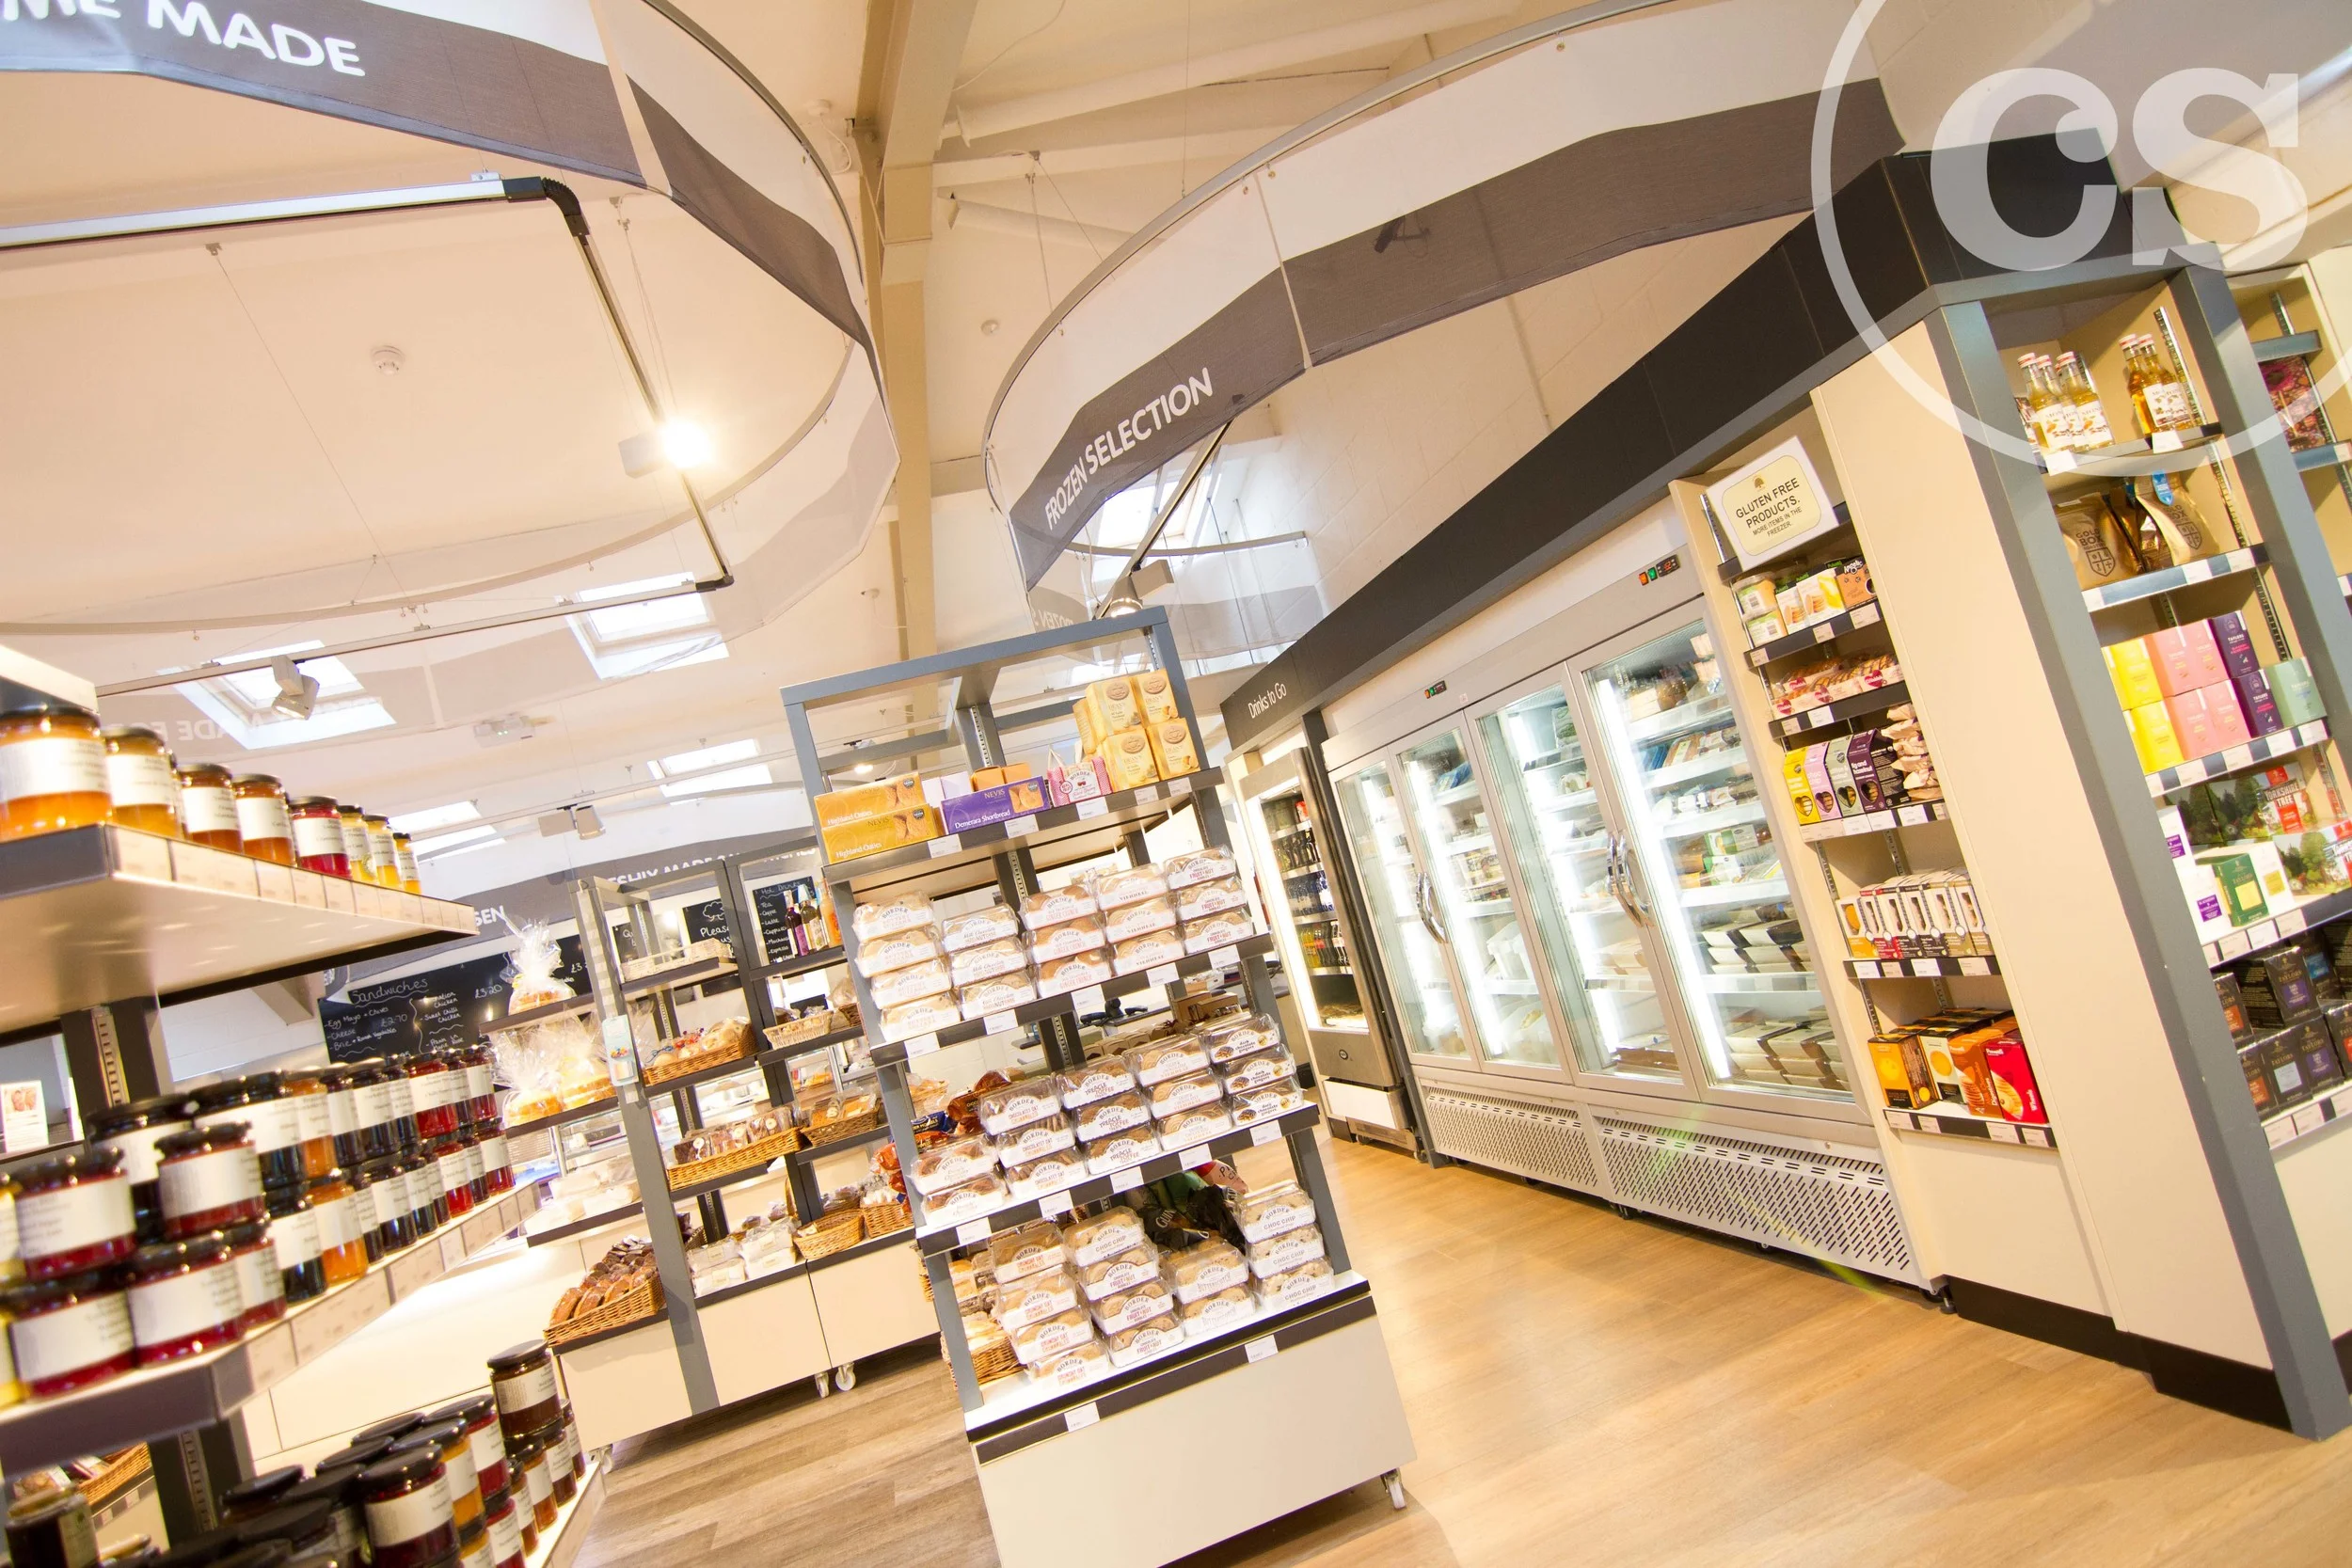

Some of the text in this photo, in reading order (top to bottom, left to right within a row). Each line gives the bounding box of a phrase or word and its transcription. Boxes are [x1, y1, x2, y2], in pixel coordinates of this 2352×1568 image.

[148, 0, 366, 76] MADE
[1044, 367, 1213, 531] FROZEN SELECTION
[1736, 477, 1800, 518] GLUTEN FREE
[1746, 495, 1801, 528] PRODUCTS.
[1753, 525, 1769, 535] MORE
[1768, 516, 1784, 528] ITEMS
[1791, 506, 1803, 516] THE
[2075, 527, 2100, 538] GOLD
[2079, 535, 2104, 546] BOX
[1248, 682, 1287, 719] Drinks to Go
[1070, 771, 1090, 780] BORDER
[984, 789, 1005, 800] NEVIS
[2265, 782, 2299, 801] YORKSHIRE
[2277, 796, 2294, 807] TREE
[827, 814, 853, 825] Highland
[867, 816, 889, 827] NEVIS
[955, 809, 1010, 829] Demerara Shortbread
[835, 842, 882, 858] Highland Oaties
[1046, 897, 1073, 909] BORDER
[1201, 901, 1216, 911] FRUIT
[1127, 911, 1152, 921] BORDER
[1054, 931, 1080, 942] BORDER
[1207, 934, 1220, 942] FRUIT
[1135, 942, 1160, 954] BORDER
[1060, 963, 1086, 976] BORDER
[351, 979, 428, 1005] Sandwiches
[434, 998, 458, 1008] Chicken
[437, 1013, 461, 1023] Chicken
[1159, 1053, 1184, 1064] BORDER
[1085, 1073, 1110, 1086] BORDER
[1085, 1083, 1107, 1096] TREACLE
[1172, 1084, 1197, 1096] BORDER
[1009, 1099, 1035, 1112] BORDER
[1099, 1106, 1124, 1120] BORDER
[1099, 1115, 1121, 1128] TREACLE
[1183, 1117, 1207, 1129] BORDER
[1023, 1132, 1049, 1144] BORDER
[1108, 1139, 1135, 1153] BORDER
[1110, 1148, 1132, 1162] TREACLE
[942, 1157, 967, 1171] BORDER
[1036, 1164, 1061, 1177] BORDER
[950, 1193, 977, 1206] BORDER
[1266, 1206, 1290, 1219] BORDER
[1263, 1215, 1295, 1230] CHOC CHIP
[1097, 1228, 1120, 1242] BORDER
[1095, 1236, 1126, 1252] CHOC CHIP
[1275, 1242, 1299, 1255] BORDER
[1017, 1247, 1042, 1260] BORDER
[1273, 1249, 1305, 1265] CHOC CHIP
[1108, 1264, 1133, 1277] BORDER
[1200, 1266, 1224, 1279] BORDER
[1110, 1278, 1124, 1288] FRUIT
[1286, 1276, 1311, 1290] BORDER
[1285, 1284, 1316, 1301] CHOC CHIP
[1025, 1293, 1050, 1307] BORDER
[1124, 1297, 1150, 1310] BORDER
[1204, 1300, 1230, 1313] BORDER
[1126, 1311, 1141, 1321] FRUIT
[1040, 1326, 1066, 1339] BORDER
[1135, 1330, 1160, 1343] BORDER
[1136, 1344, 1151, 1354] FRUIT
[1057, 1359, 1083, 1371] BORDER
